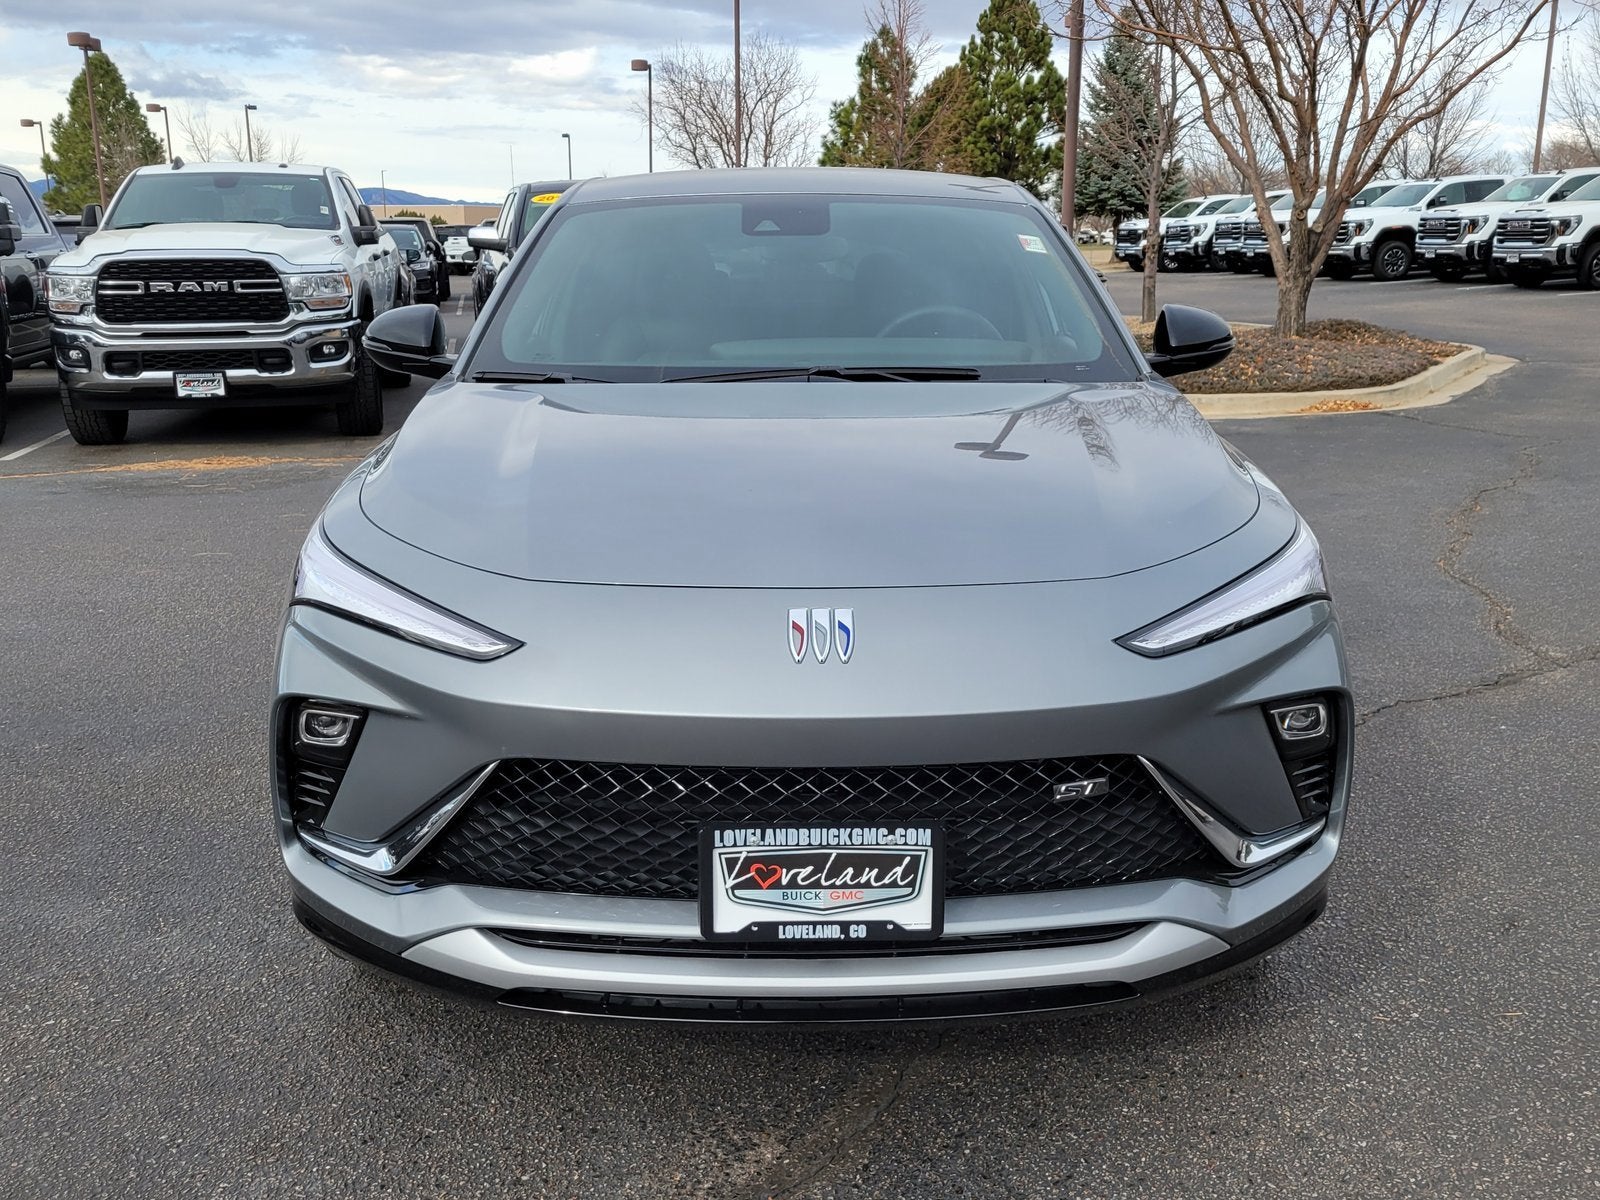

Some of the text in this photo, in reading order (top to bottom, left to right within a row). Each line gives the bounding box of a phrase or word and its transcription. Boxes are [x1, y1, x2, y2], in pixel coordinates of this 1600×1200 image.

[149, 281, 229, 293] RAM
[1053, 775, 1107, 800] ST
[713, 827, 932, 847] LOVELANDBUICKGMCCOM
[782, 890, 865, 901] BUICK GMC
[778, 924, 867, 939] LOVELAND, CO
